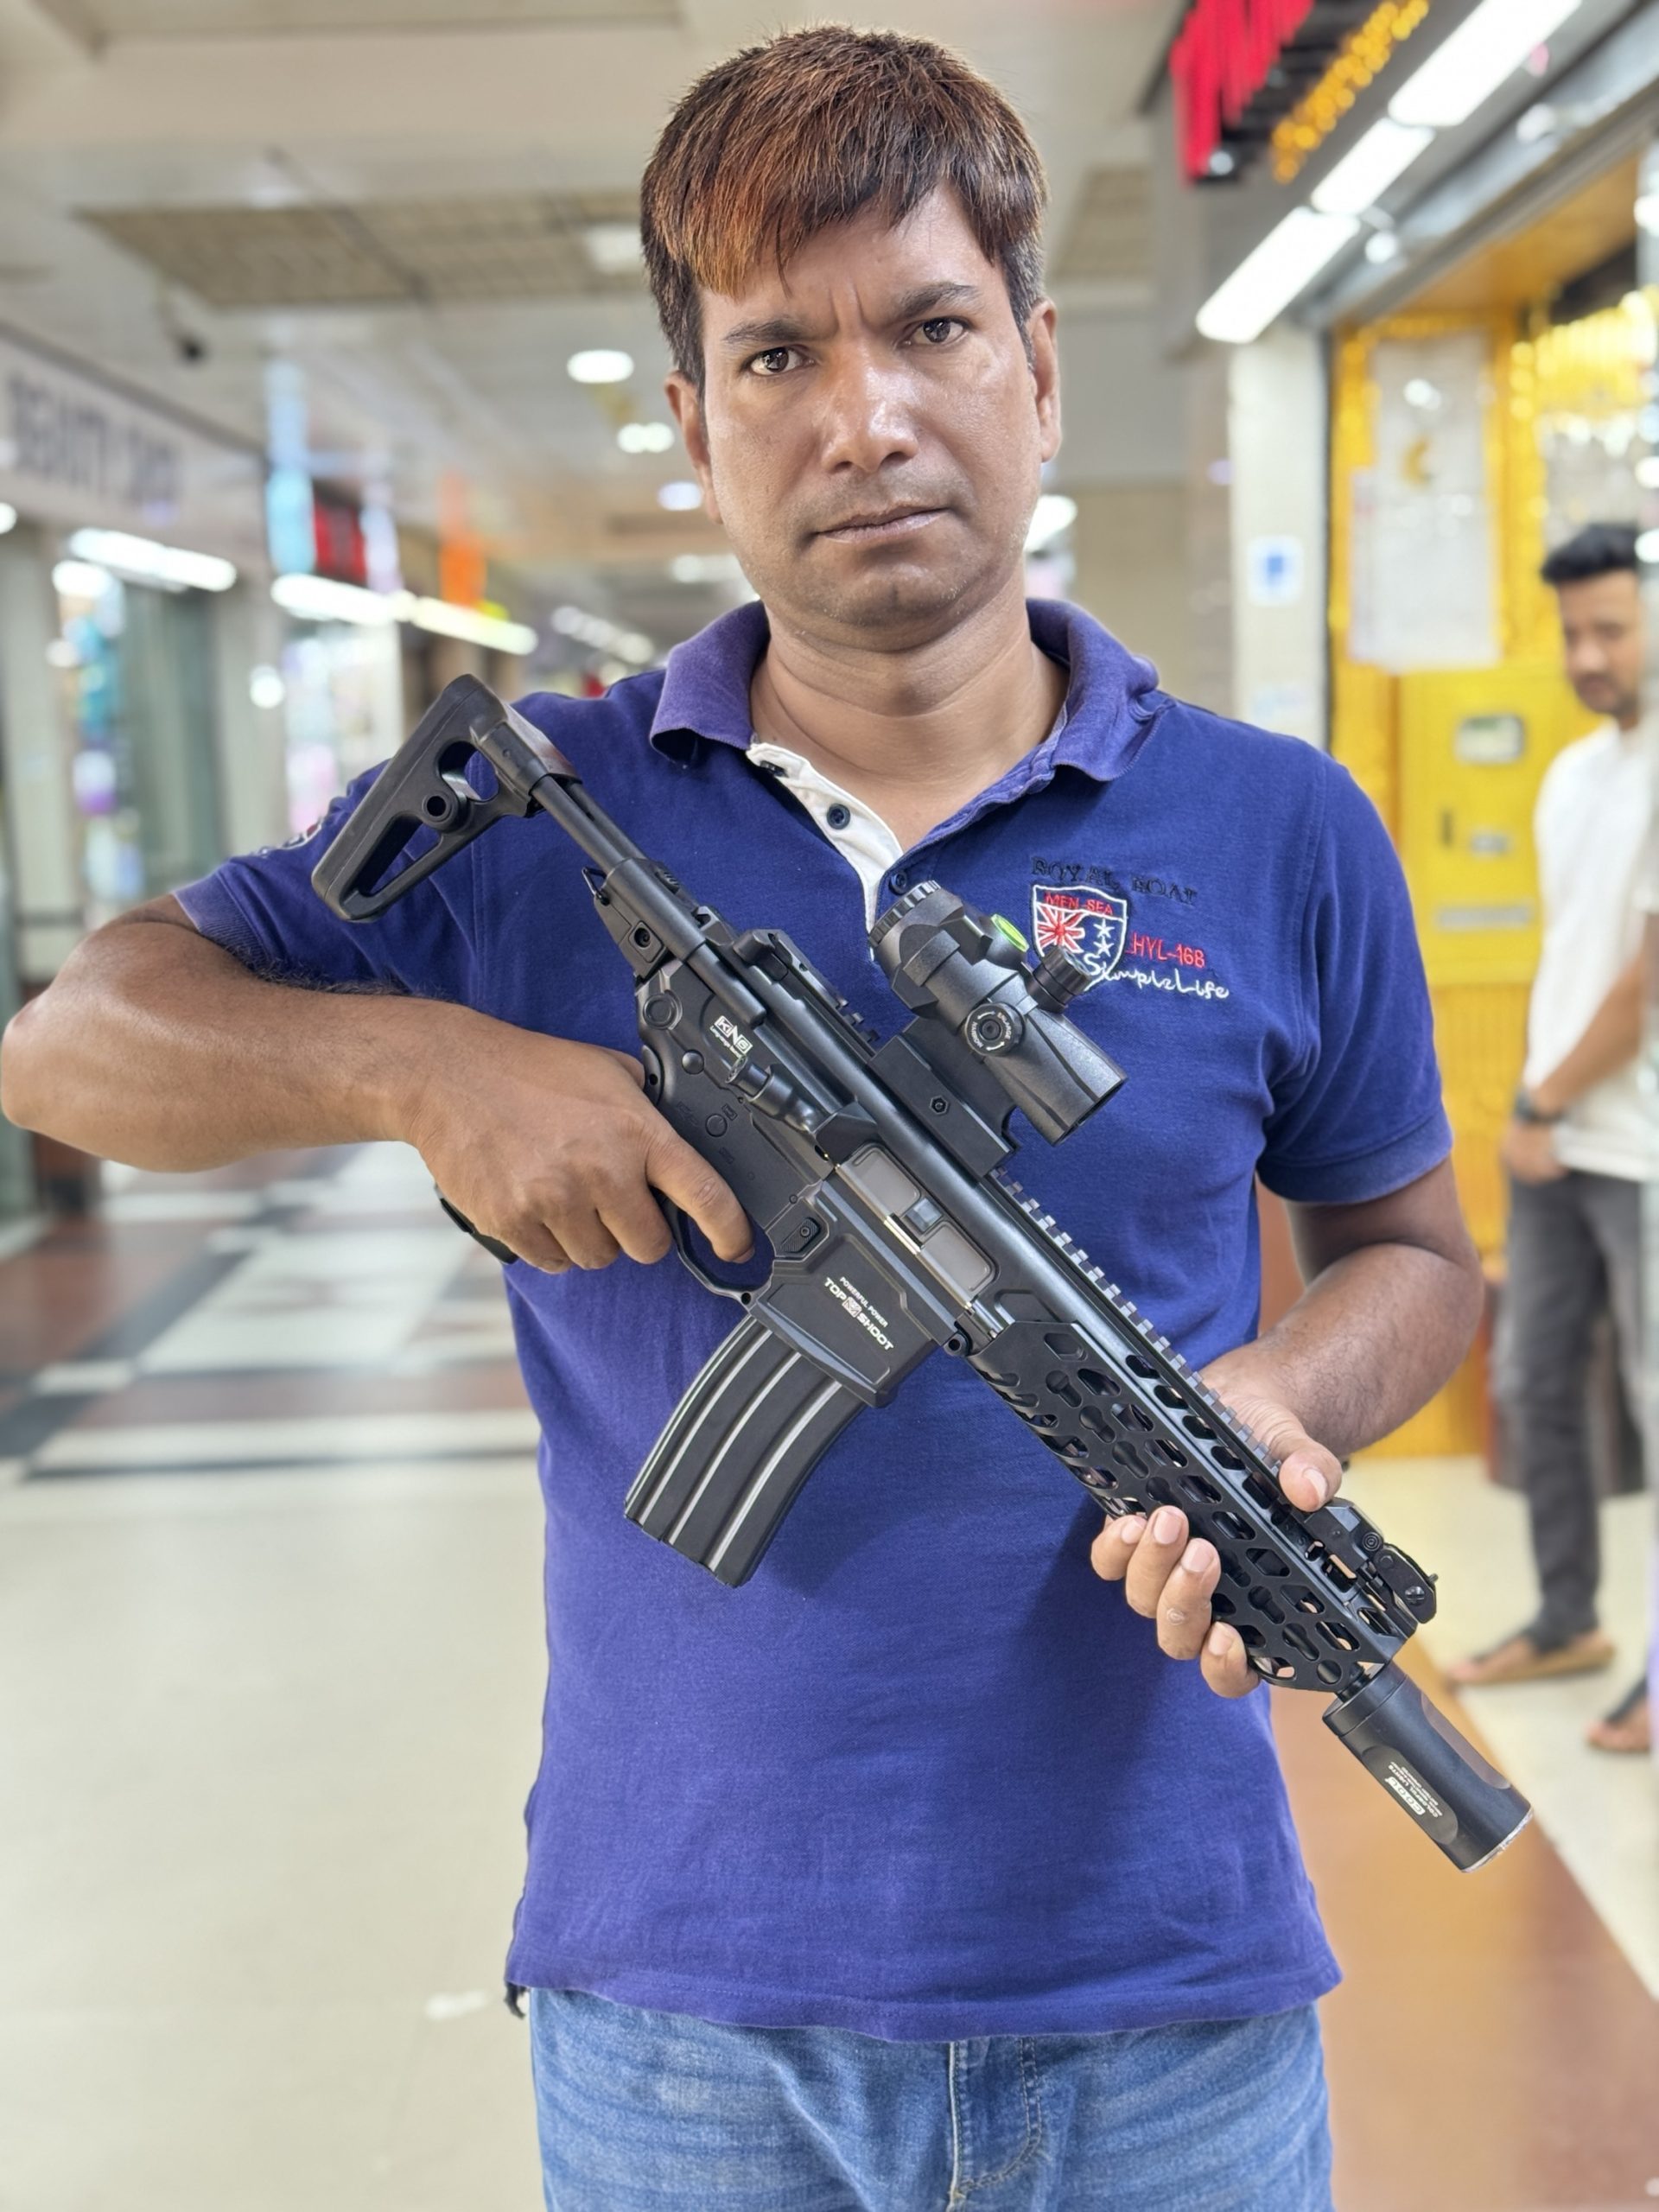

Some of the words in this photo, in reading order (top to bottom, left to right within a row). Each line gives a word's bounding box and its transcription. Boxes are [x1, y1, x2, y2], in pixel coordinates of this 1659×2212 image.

[1130, 931, 1205, 969] HYL-168
[714, 1015, 753, 1055] KING
[824, 1277, 848, 1301] TOP
[856, 1312, 894, 1351] SHOOT
[839, 1276, 868, 1308] POWERFUL
[868, 1306, 888, 1327] POWER
